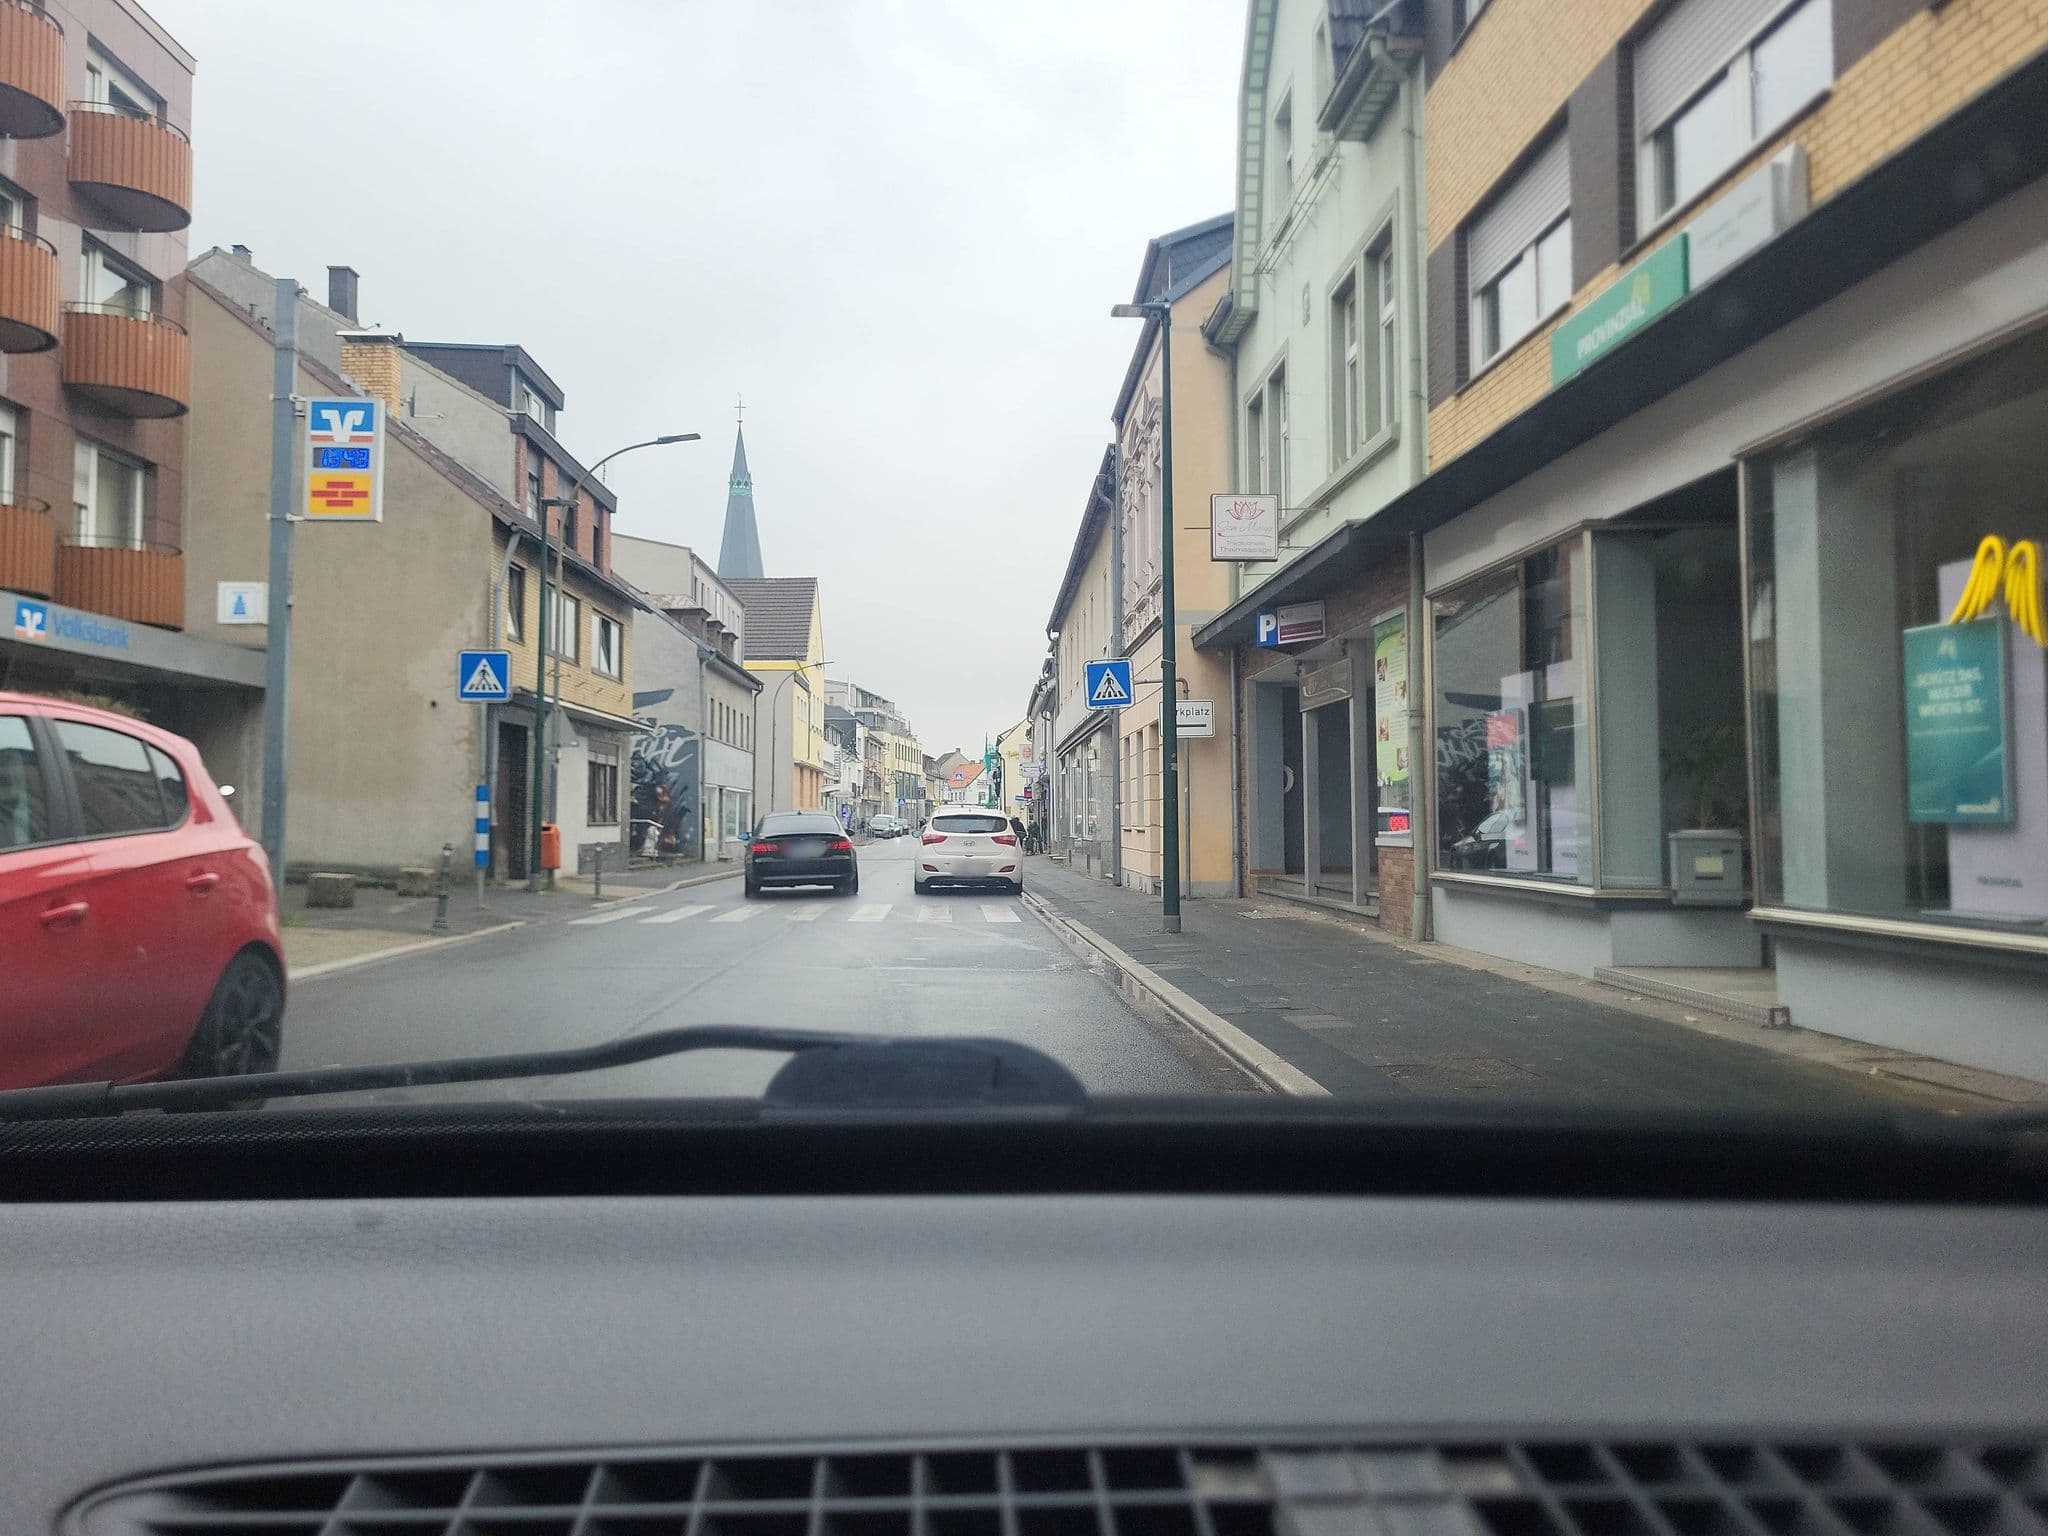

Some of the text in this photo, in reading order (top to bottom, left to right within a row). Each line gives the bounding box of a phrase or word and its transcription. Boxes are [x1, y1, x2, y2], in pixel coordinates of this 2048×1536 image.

[1577, 297, 1646, 360] PROVINZIAL
[53, 611, 128, 649] Volksbank
[1260, 613, 1276, 642] P
